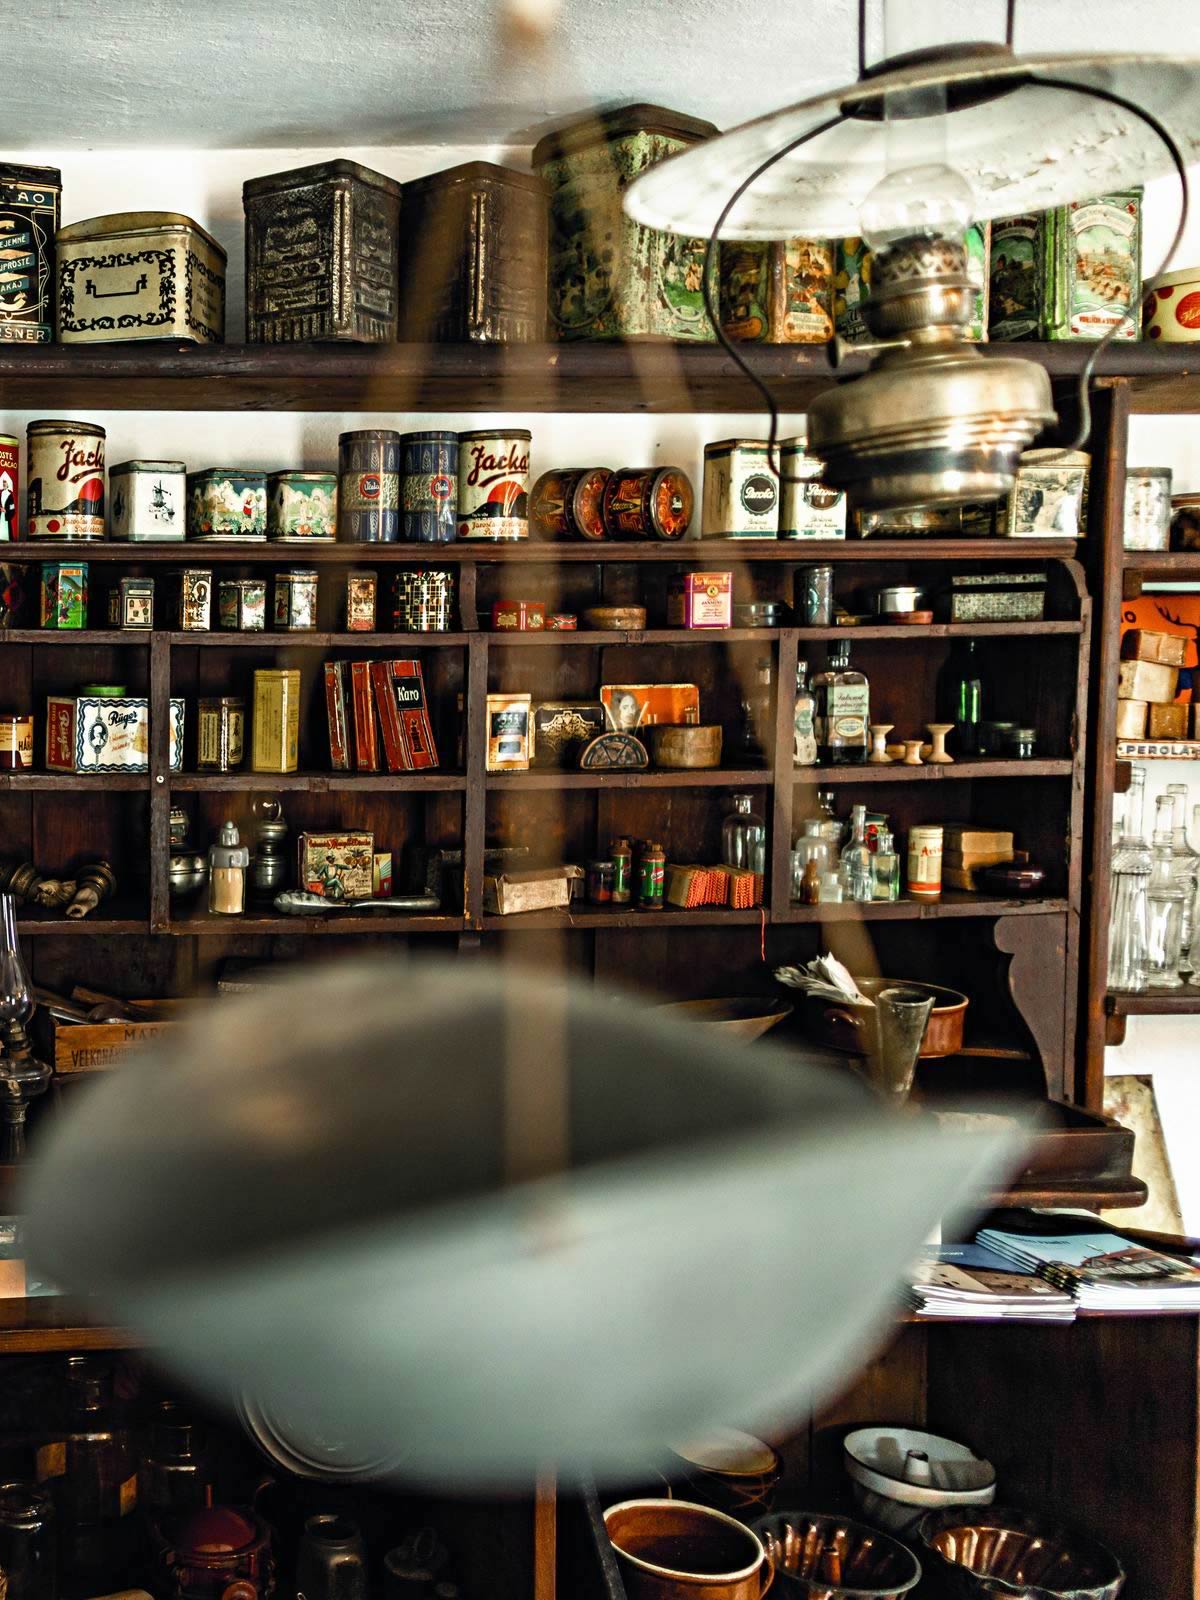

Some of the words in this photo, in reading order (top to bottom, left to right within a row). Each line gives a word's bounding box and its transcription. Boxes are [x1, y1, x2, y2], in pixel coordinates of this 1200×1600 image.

[0, 458, 17, 469] CACAO
[467, 444, 529, 486] Jacka
[397, 686, 419, 702] Karo
[1126, 745, 1190, 755] PEROLA
